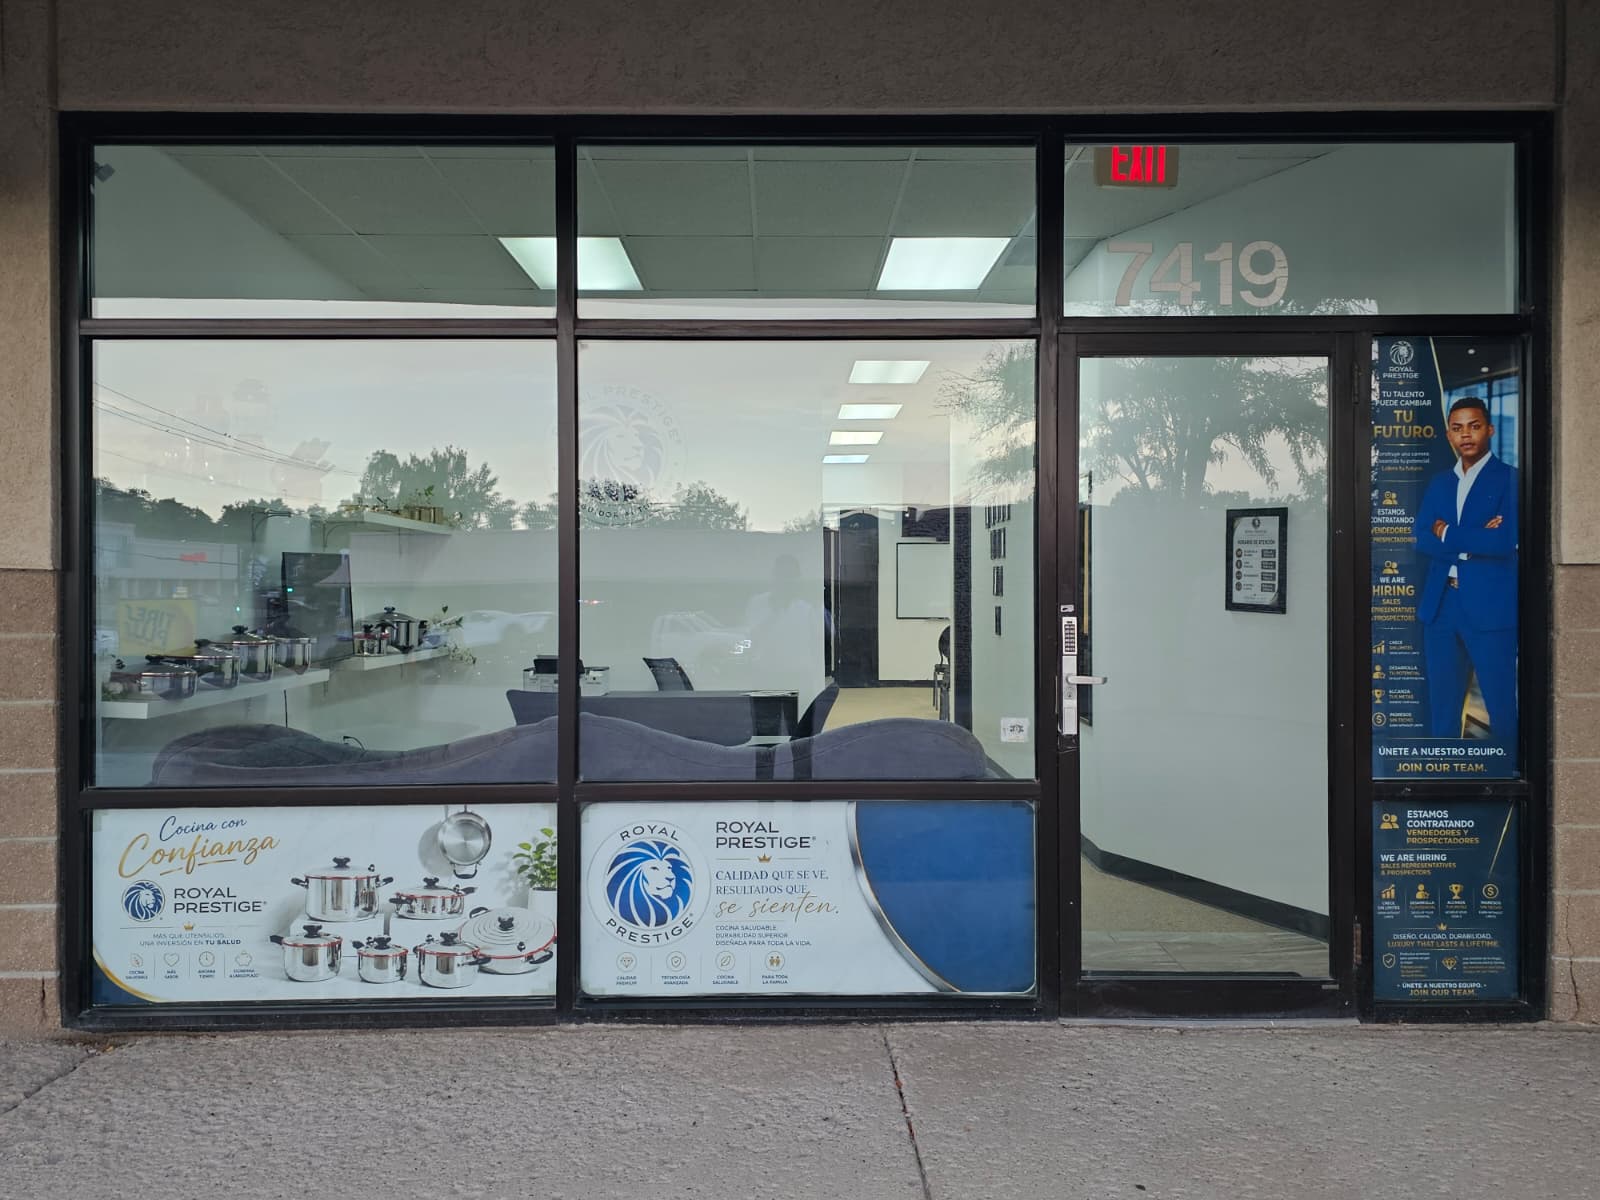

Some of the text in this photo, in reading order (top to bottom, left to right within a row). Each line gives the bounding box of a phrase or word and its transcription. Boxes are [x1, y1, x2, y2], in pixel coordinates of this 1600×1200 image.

[1107, 240, 1288, 307] 7419
[1393, 410, 1413, 423] TU
[1374, 426, 1437, 438] FUTURO.
[1372, 585, 1415, 596] HIRING
[1378, 746, 1507, 756] ÚNETE A NUESTRO EQUIPO.
[1396, 763, 1487, 772] JOIN OUR TEAM.
[1407, 810, 1448, 818] ESTAMOS
[159, 815, 247, 842] Cocina con
[716, 821, 779, 833] ROYAL
[1407, 820, 1475, 828] CONTRATANDO
[619, 824, 679, 841] ROYAL
[716, 837, 812, 848] PRESTIGE
[118, 833, 280, 878] Confianza
[716, 871, 768, 880] CALIDAD
[772, 870, 794, 880] QUE
[797, 870, 810, 880] SE
[174, 887, 237, 899] ROYAL
[716, 884, 808, 895] RESULTADOS QUE
[174, 900, 263, 914] PRESTIGE
[715, 891, 839, 923] se sienten.
[606, 918, 694, 944] PRESTIGE
